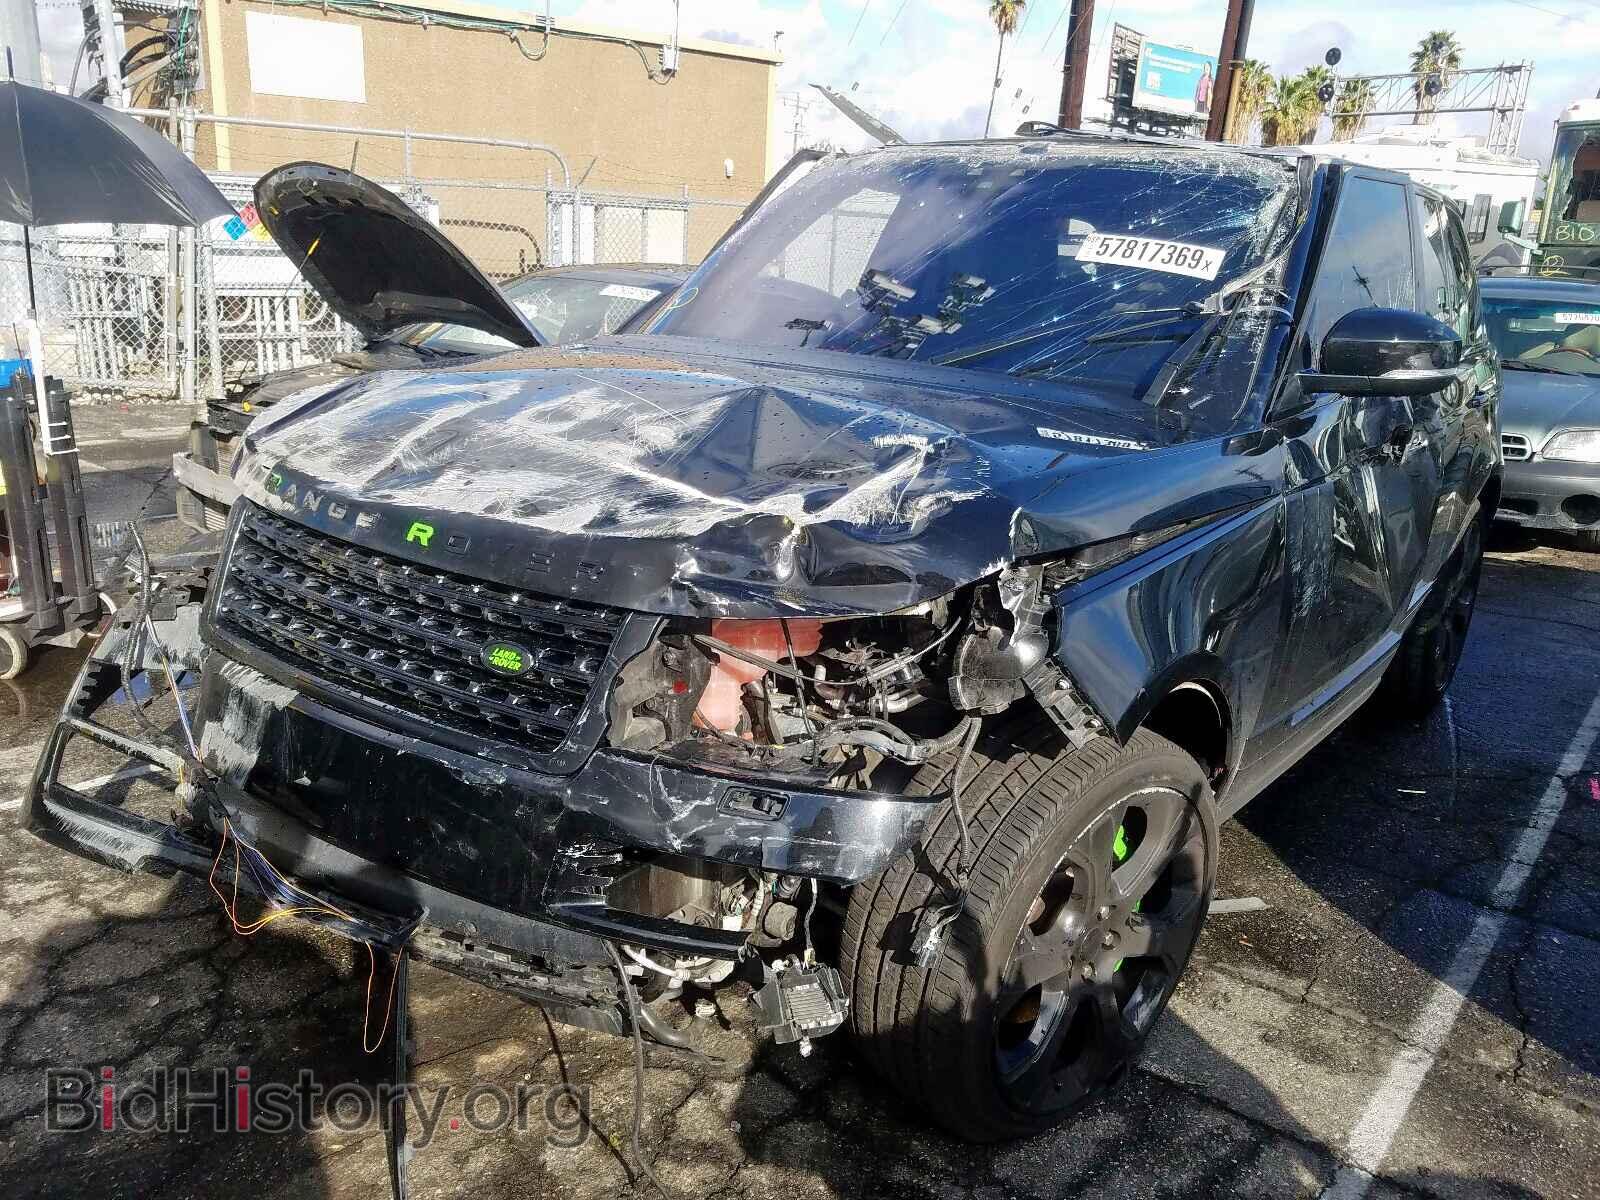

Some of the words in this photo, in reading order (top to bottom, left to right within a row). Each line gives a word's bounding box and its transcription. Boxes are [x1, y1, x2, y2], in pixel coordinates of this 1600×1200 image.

[1095, 237, 1205, 270] 57817369
[492, 647, 517, 661] LAND
[492, 657, 522, 670] ROVER
